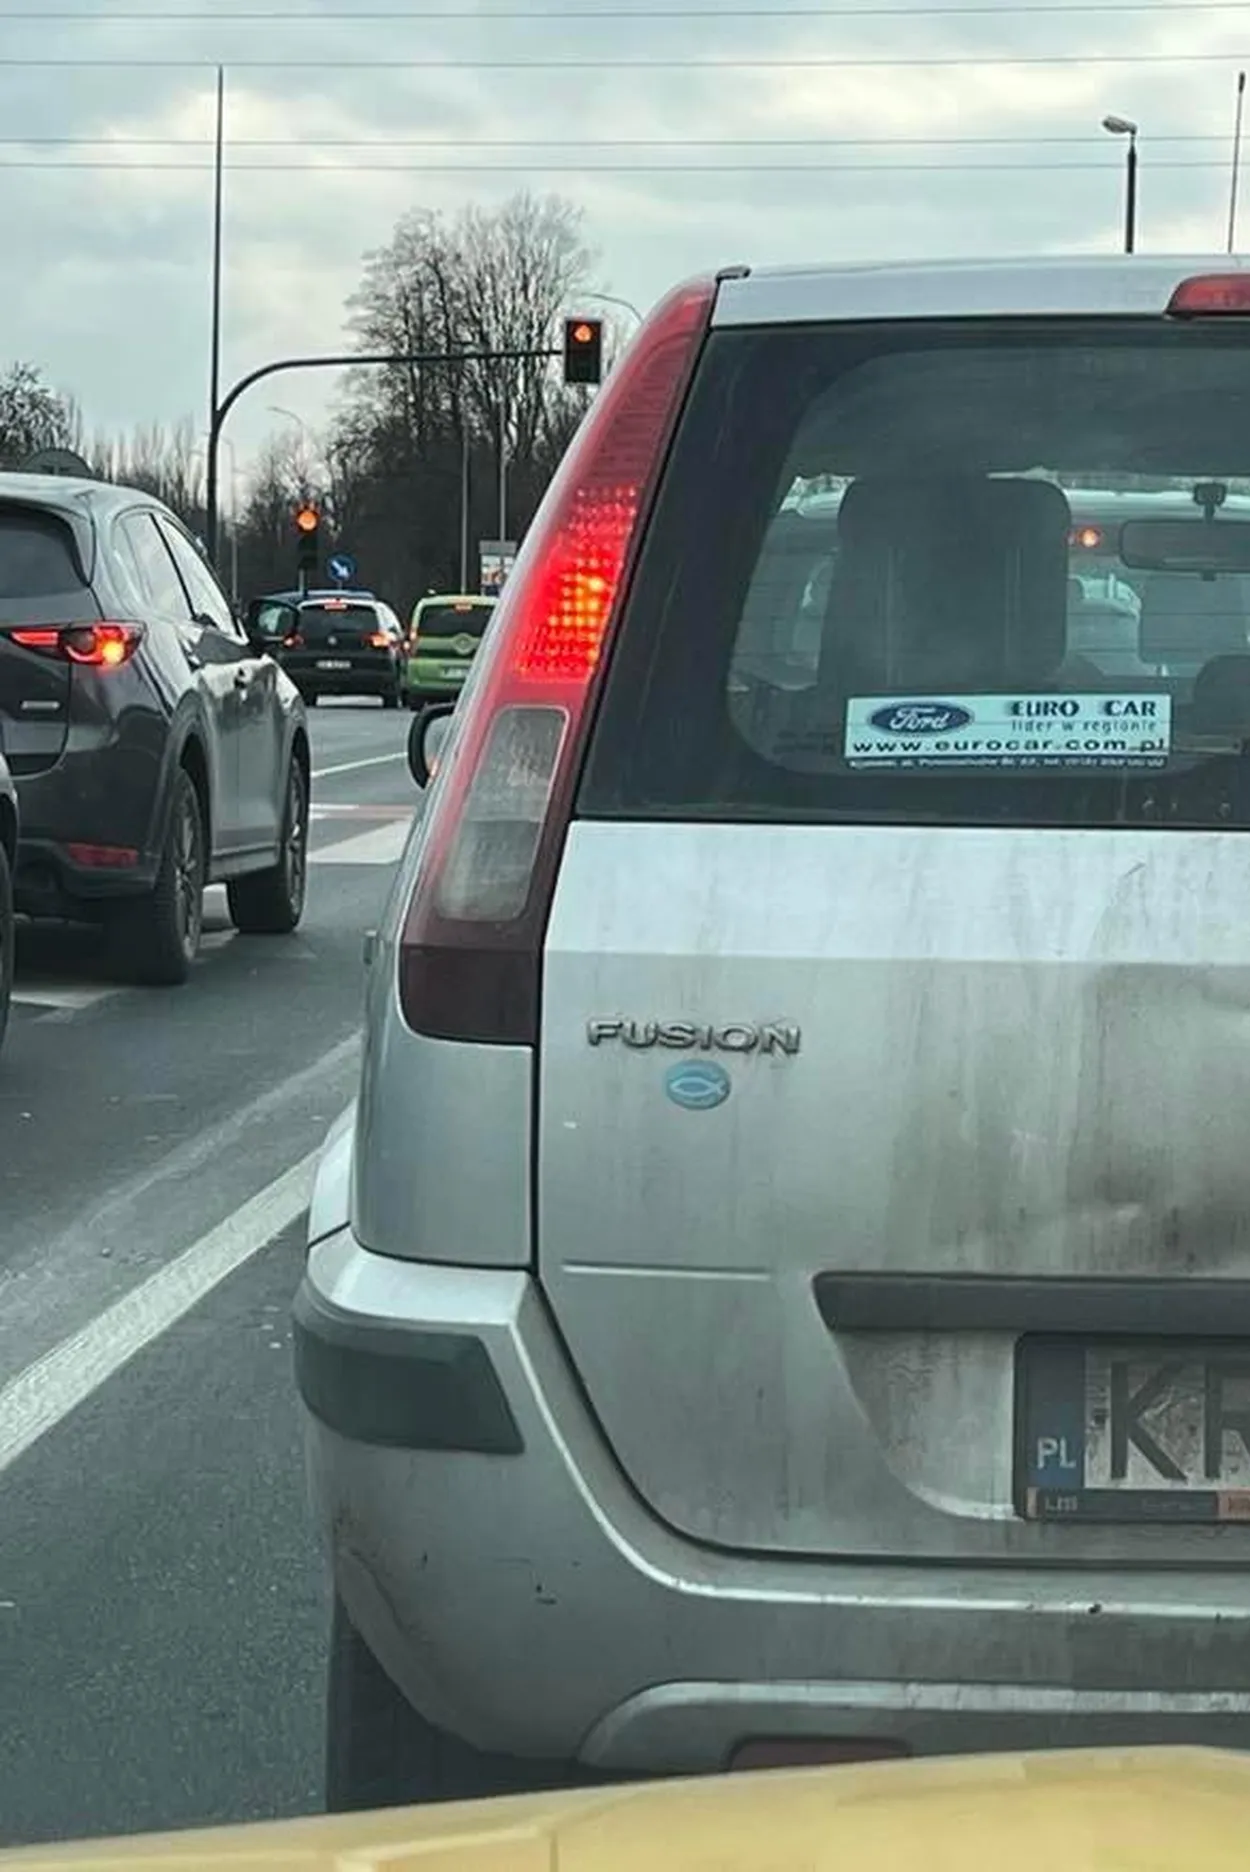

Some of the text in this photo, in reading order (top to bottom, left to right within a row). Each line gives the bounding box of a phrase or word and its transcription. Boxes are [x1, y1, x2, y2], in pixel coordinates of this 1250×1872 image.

[889, 706, 951, 730] Ford
[1007, 699, 1157, 718] EURO CAR
[1012, 719, 1158, 735] lider w regionie
[852, 737, 1165, 754] www.eurocar.com.pl
[587, 1020, 802, 1056] FUSION
[1037, 1436, 1077, 1470] PL
